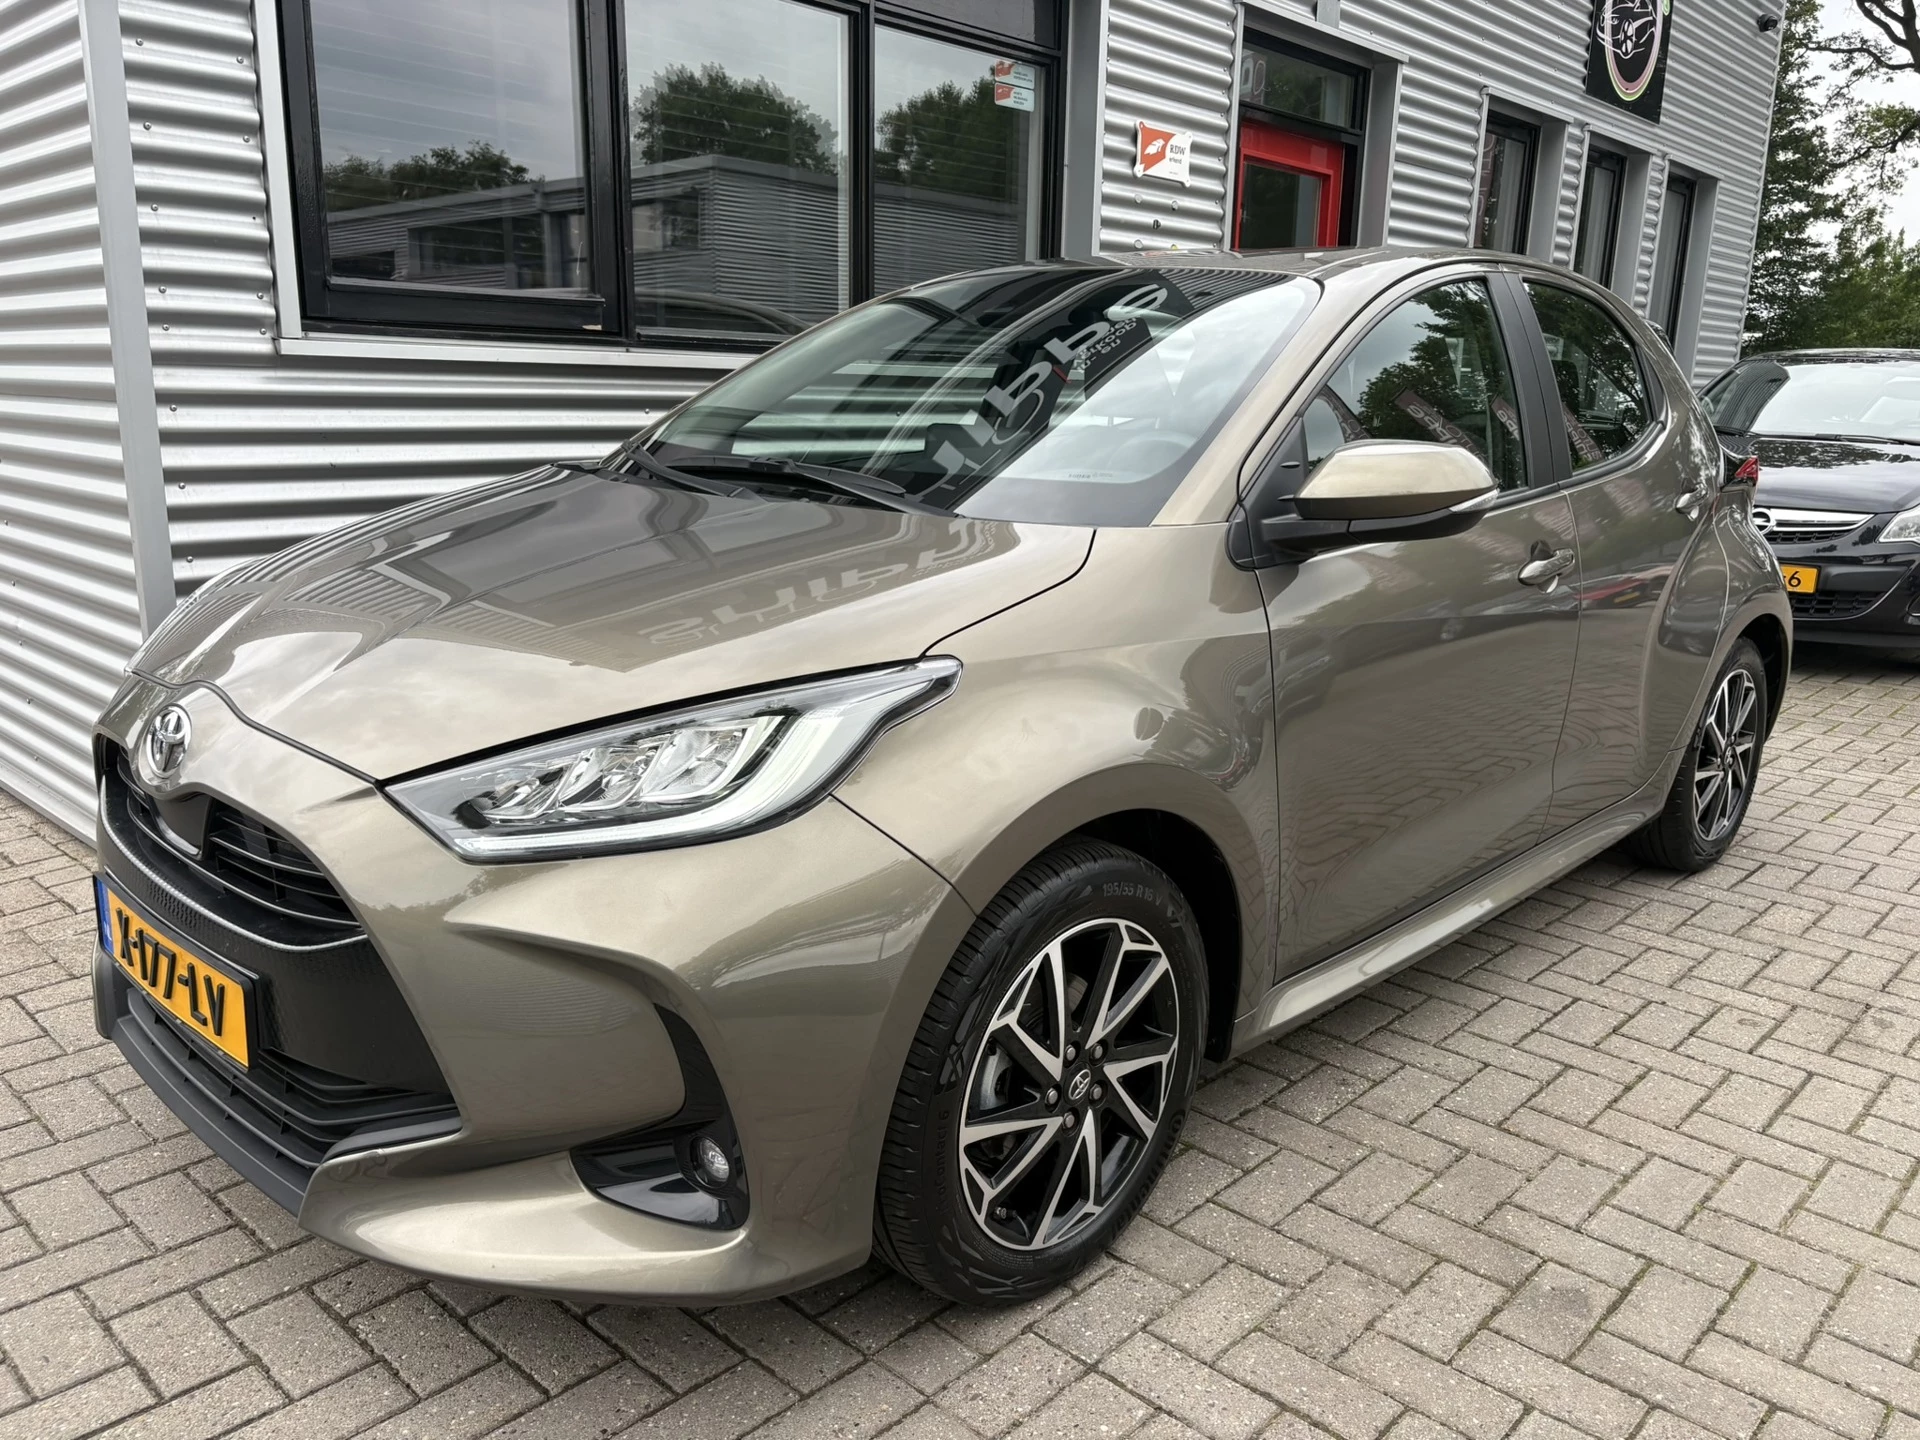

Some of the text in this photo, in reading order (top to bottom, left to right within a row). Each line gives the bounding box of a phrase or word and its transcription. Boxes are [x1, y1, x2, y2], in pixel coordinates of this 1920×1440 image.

[1169, 145, 1186, 156] RDW
[1102, 881, 1135, 897] 195/55
[116, 907, 225, 1037] X-177-LV
